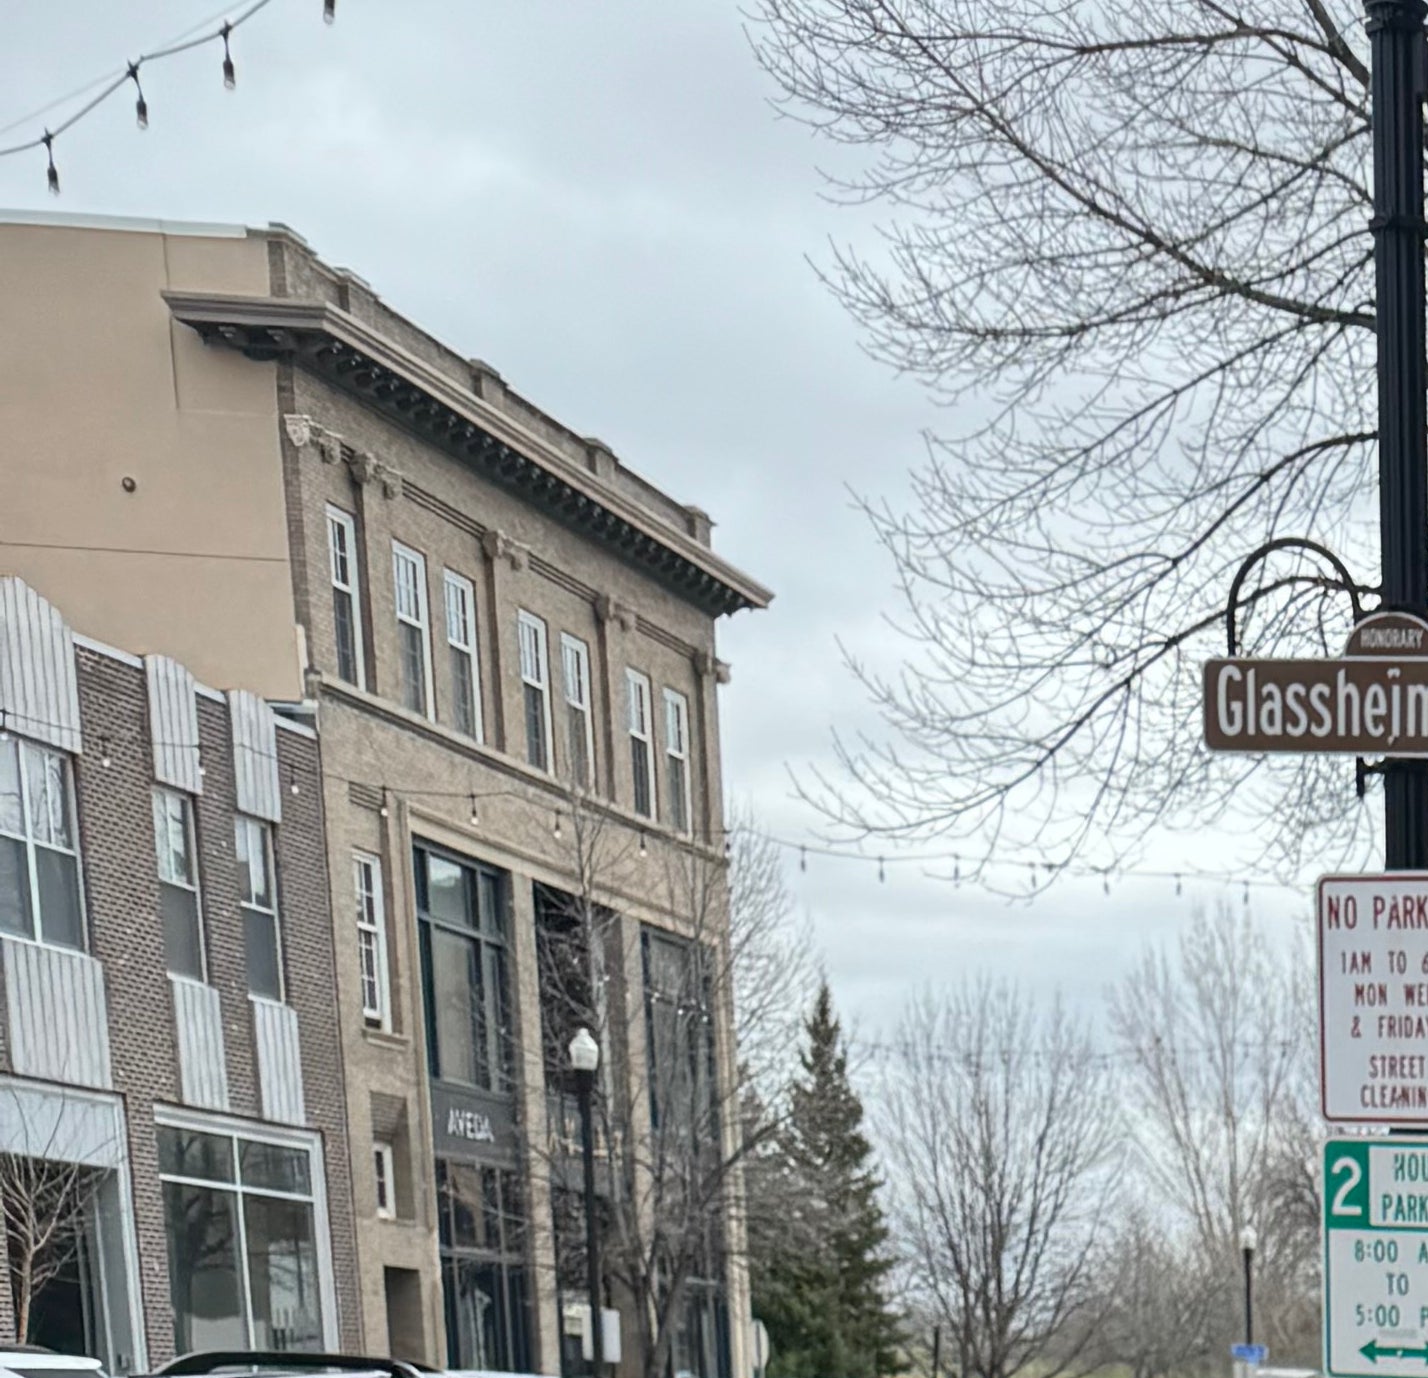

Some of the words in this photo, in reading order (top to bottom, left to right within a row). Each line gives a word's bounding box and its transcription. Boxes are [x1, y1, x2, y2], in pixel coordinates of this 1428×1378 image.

[1360, 628, 1424, 649] HONORARY
[1327, 895, 1358, 930] NO
[1341, 952, 1372, 975] 1AM
[1388, 952, 1407, 975] TO
[1354, 983, 1388, 1007] MON
[1351, 1015, 1362, 1039] &
[1369, 1055, 1426, 1079] STREET
[447, 1107, 495, 1143] AVEDA
[1331, 1156, 1363, 1217] 2
[1354, 1240, 1399, 1264] 8:00
[1386, 1273, 1409, 1296] TO
[1356, 1304, 1400, 1328] 5:00
